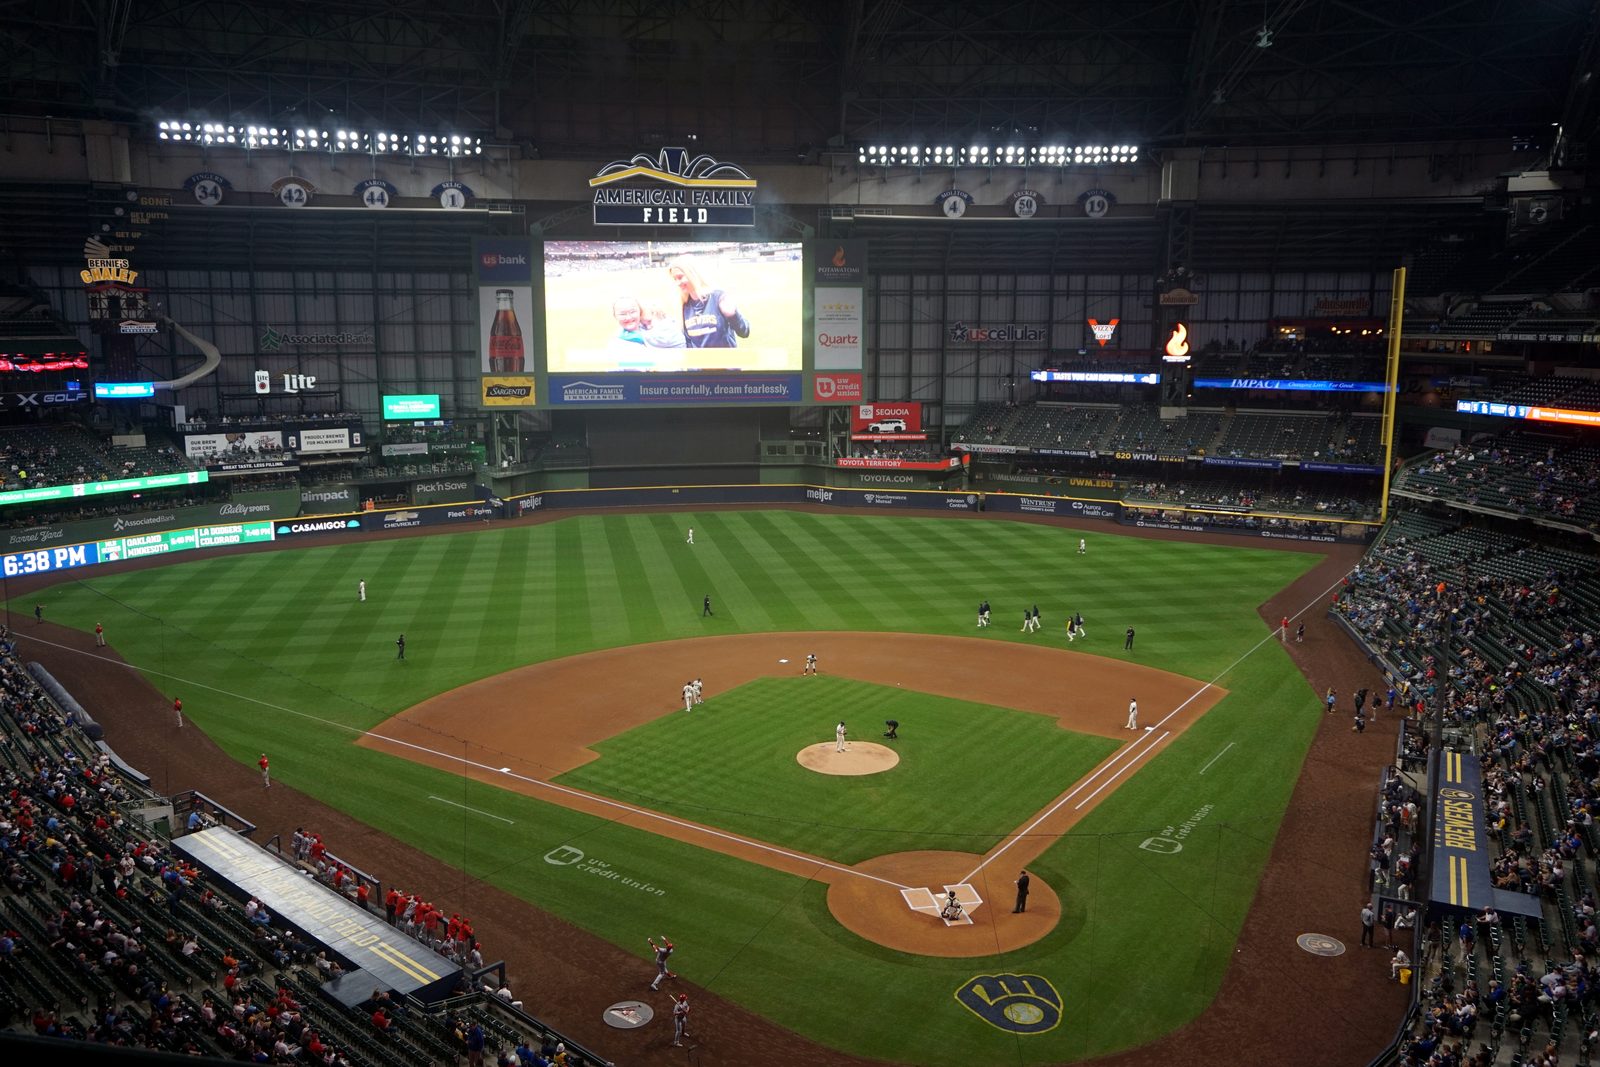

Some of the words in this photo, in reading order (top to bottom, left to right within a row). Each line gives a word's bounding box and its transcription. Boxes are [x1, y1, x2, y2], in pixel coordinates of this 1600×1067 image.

[441, 181, 461, 191] SELIG
[197, 185, 219, 200] 34
[283, 188, 304, 202] 42
[366, 191, 386, 205] 44
[594, 189, 686, 205] AMERICAN
[692, 189, 753, 206] FAMILY
[140, 197, 173, 207] GONE!
[449, 193, 458, 207] 1
[1018, 199, 1033, 209] 50
[949, 201, 958, 213] 4
[1088, 200, 1105, 213] 19
[643, 207, 708, 224] FIELD
[89, 259, 129, 269] BERNIE'S
[80, 268, 138, 285] CHALET
[818, 332, 858, 348] Quartz
[256, 374, 268, 382] Lite
[283, 374, 316, 394] Lite
[1230, 379, 1280, 389] IMPACT
[489, 386, 527, 397] SARGENTO
[640, 385, 669, 395] Insure
[670, 385, 712, 397] carefully,
[713, 385, 743, 394] dream
[743, 384, 789, 397] fearlessly.
[837, 382, 860, 390] credit
[43, 393, 88, 403] GOLF
[837, 389, 860, 397] union
[875, 408, 910, 416] SEQUOIA
[1115, 452, 1132, 460] 620
[1132, 453, 1156, 462] WTMJ
[838, 459, 865, 467] TOYOTA
[866, 460, 902, 468] TERRITORY
[860, 474, 914, 483] TOYOTA.COM
[1069, 479, 1114, 489] UWM.EDU
[444, 481, 467, 491] Save
[308, 489, 350, 503] impact
[806, 488, 833, 503] meijer
[520, 496, 543, 510] meijer
[1020, 498, 1056, 508] WINTRUST
[219, 503, 249, 516] Bally
[249, 504, 270, 513] SPORTS
[447, 510, 466, 519] Fleet
[291, 521, 347, 534] CASAMIGOS
[383, 520, 421, 529] CHEVROLET
[9, 530, 39, 545] Barrel
[40, 529, 64, 543] Yard
[199, 528, 210, 537] LA
[260, 527, 271, 537] PM
[127, 534, 163, 547] OAKLAND
[184, 534, 195, 544] PM
[199, 535, 241, 547] COLORADO
[128, 543, 170, 557] MINNESOTA
[3, 550, 51, 576] 6:38
[55, 545, 87, 569] PM
[1443, 799, 1478, 852] BREWERS
[587, 857, 612, 869] uw
[576, 863, 621, 881] credit
[621, 877, 666, 897] union
[329, 918, 381, 948] FIELD
